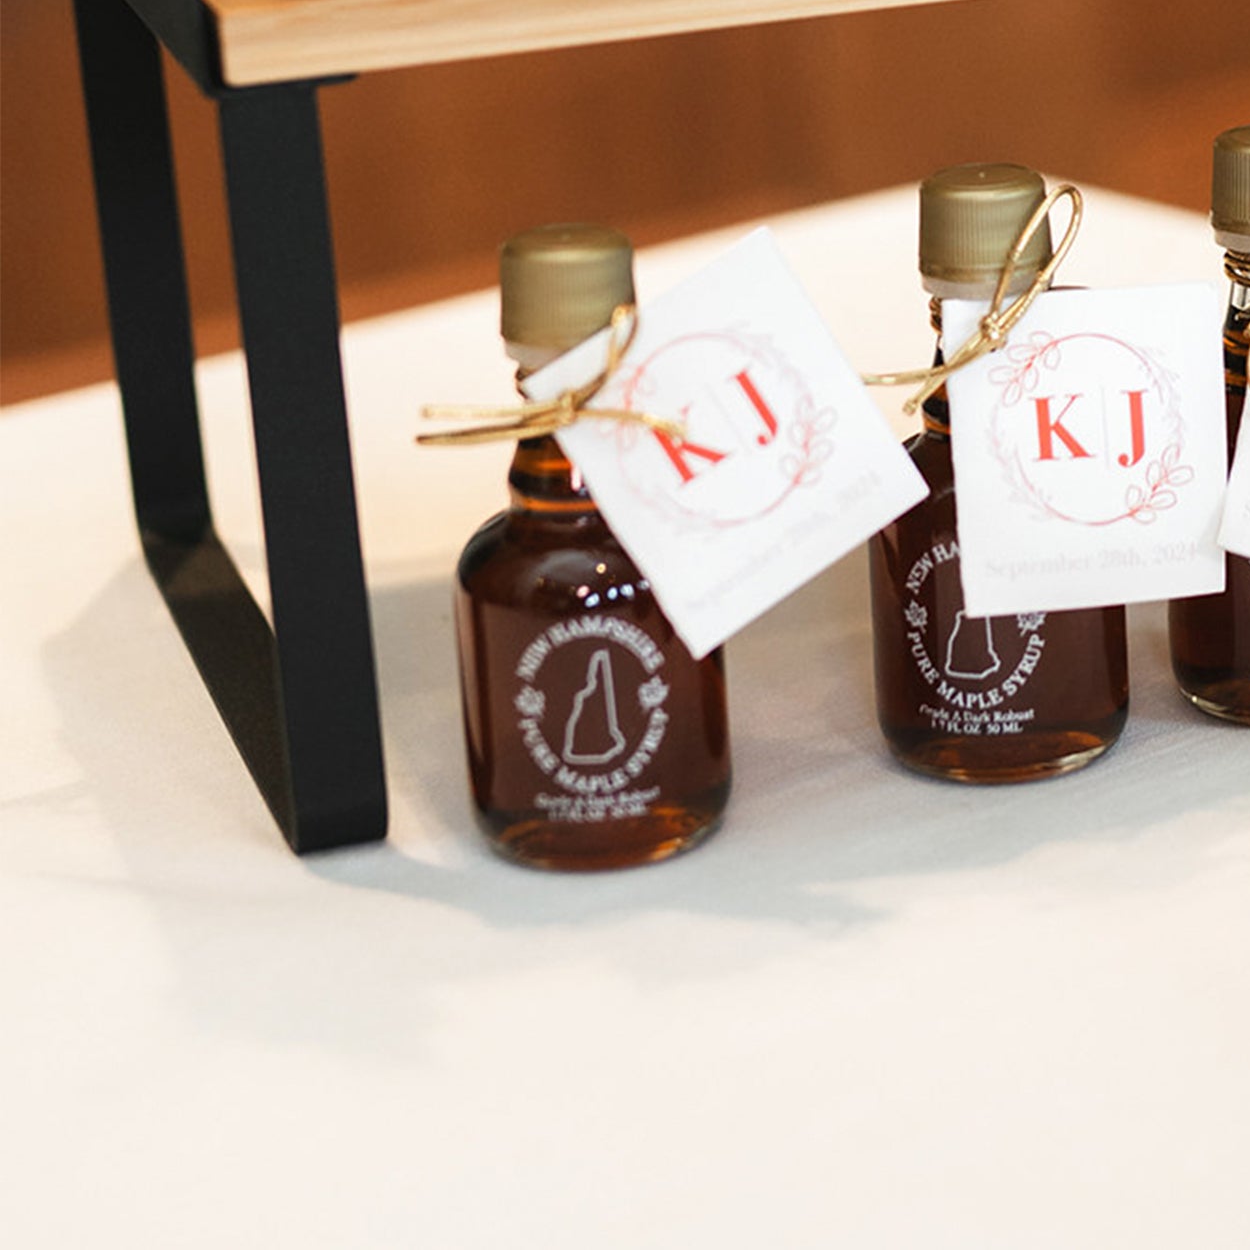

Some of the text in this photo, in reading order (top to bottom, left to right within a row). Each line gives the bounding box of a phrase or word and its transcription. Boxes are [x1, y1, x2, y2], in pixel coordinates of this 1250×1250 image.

[653, 361, 778, 487] K J
[1028, 388, 1149, 468] K J
[905, 552, 934, 595] NEW
[982, 548, 1091, 580] September
[515, 614, 665, 682] NEW HAMPSHIRE
[908, 632, 1046, 710] PURE MAPLE SYRUP
[518, 708, 670, 795] PURE MAPLE SYRUP
[947, 721, 962, 734] FL
[964, 722, 981, 734] OZ
[1002, 721, 1024, 733] ML
